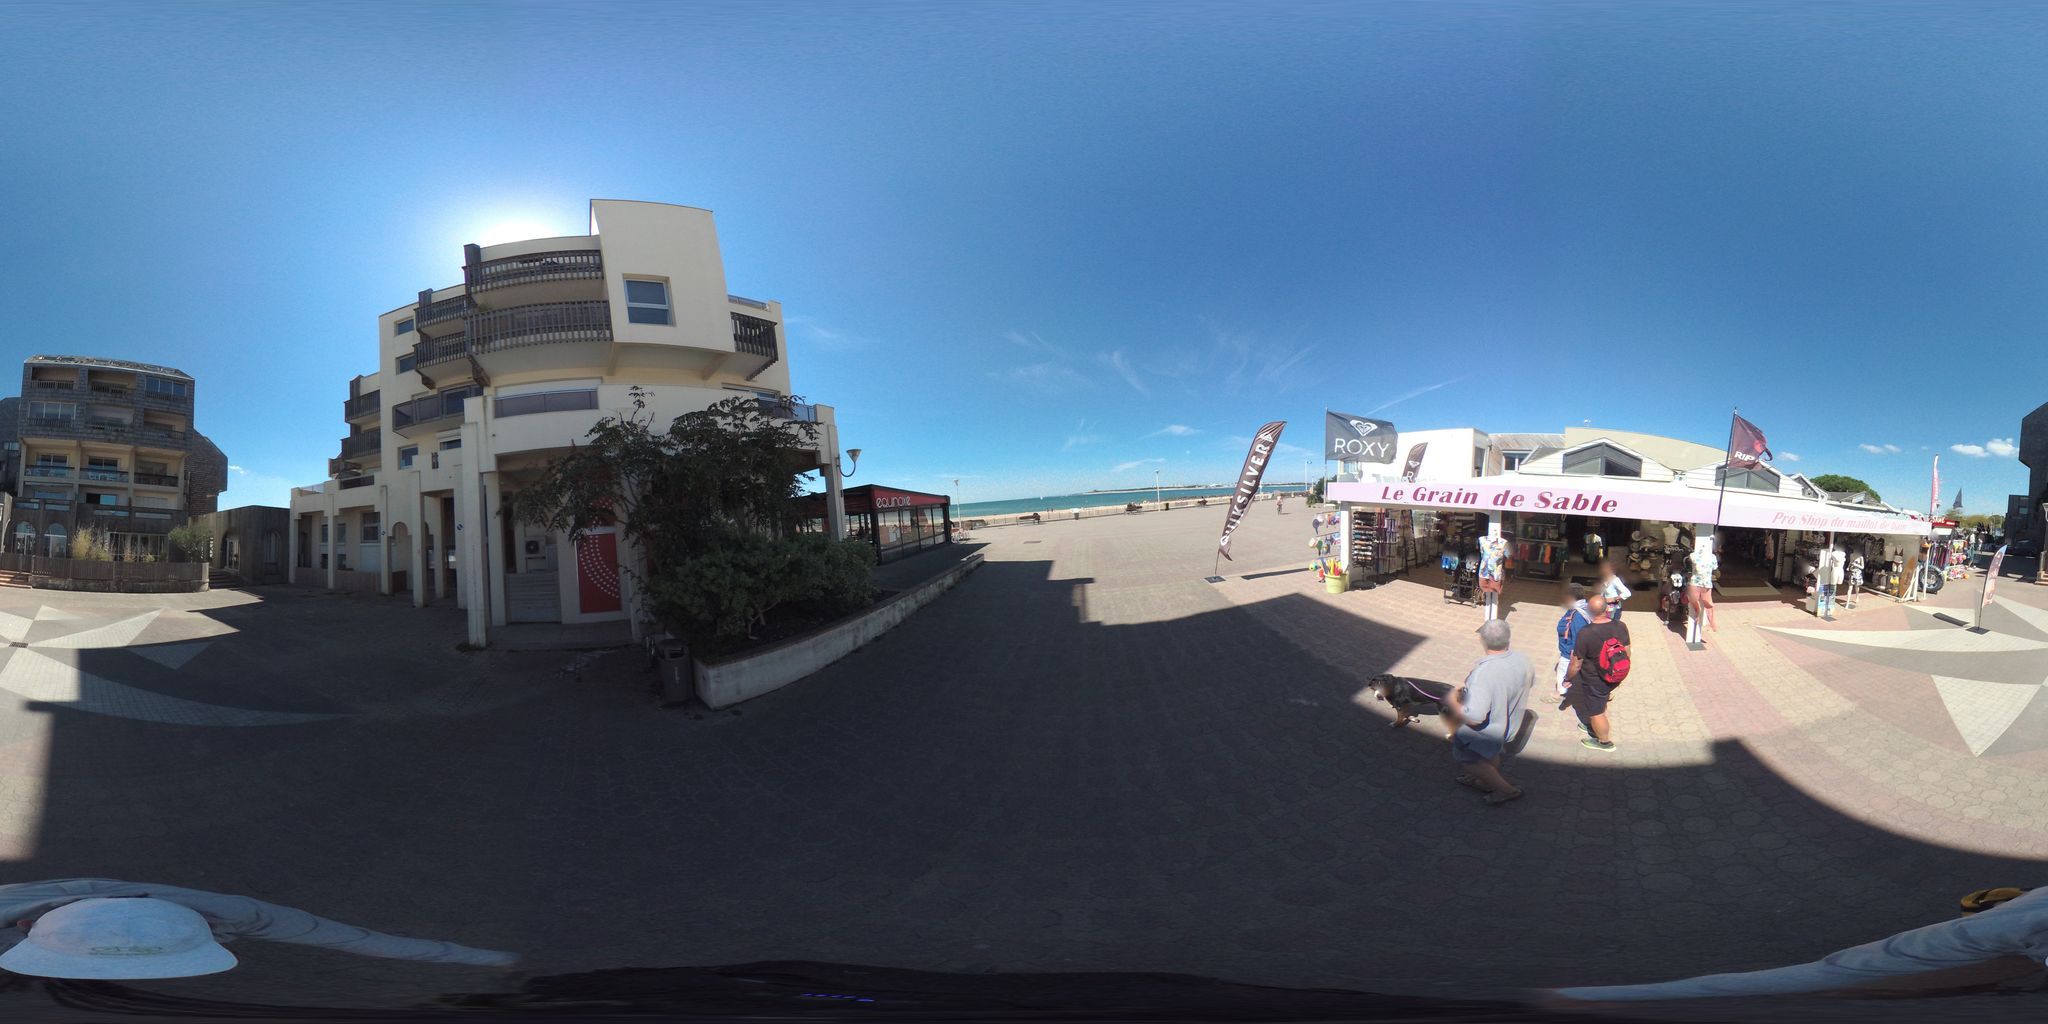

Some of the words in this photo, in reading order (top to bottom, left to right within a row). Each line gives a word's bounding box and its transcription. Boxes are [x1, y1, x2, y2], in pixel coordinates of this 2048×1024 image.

[1334, 438, 1389, 458] ROXY
[1734, 451, 1755, 461] RIP
[1382, 486, 1404, 500] Le
[1412, 486, 1478, 504] Grain
[1492, 490, 1525, 507] de
[1534, 491, 1618, 513] Sable
[1772, 511, 1796, 525] Pro
[1800, 513, 1829, 528] Shop
[1831, 516, 1844, 527] du
[1847, 517, 1877, 529] maillot
